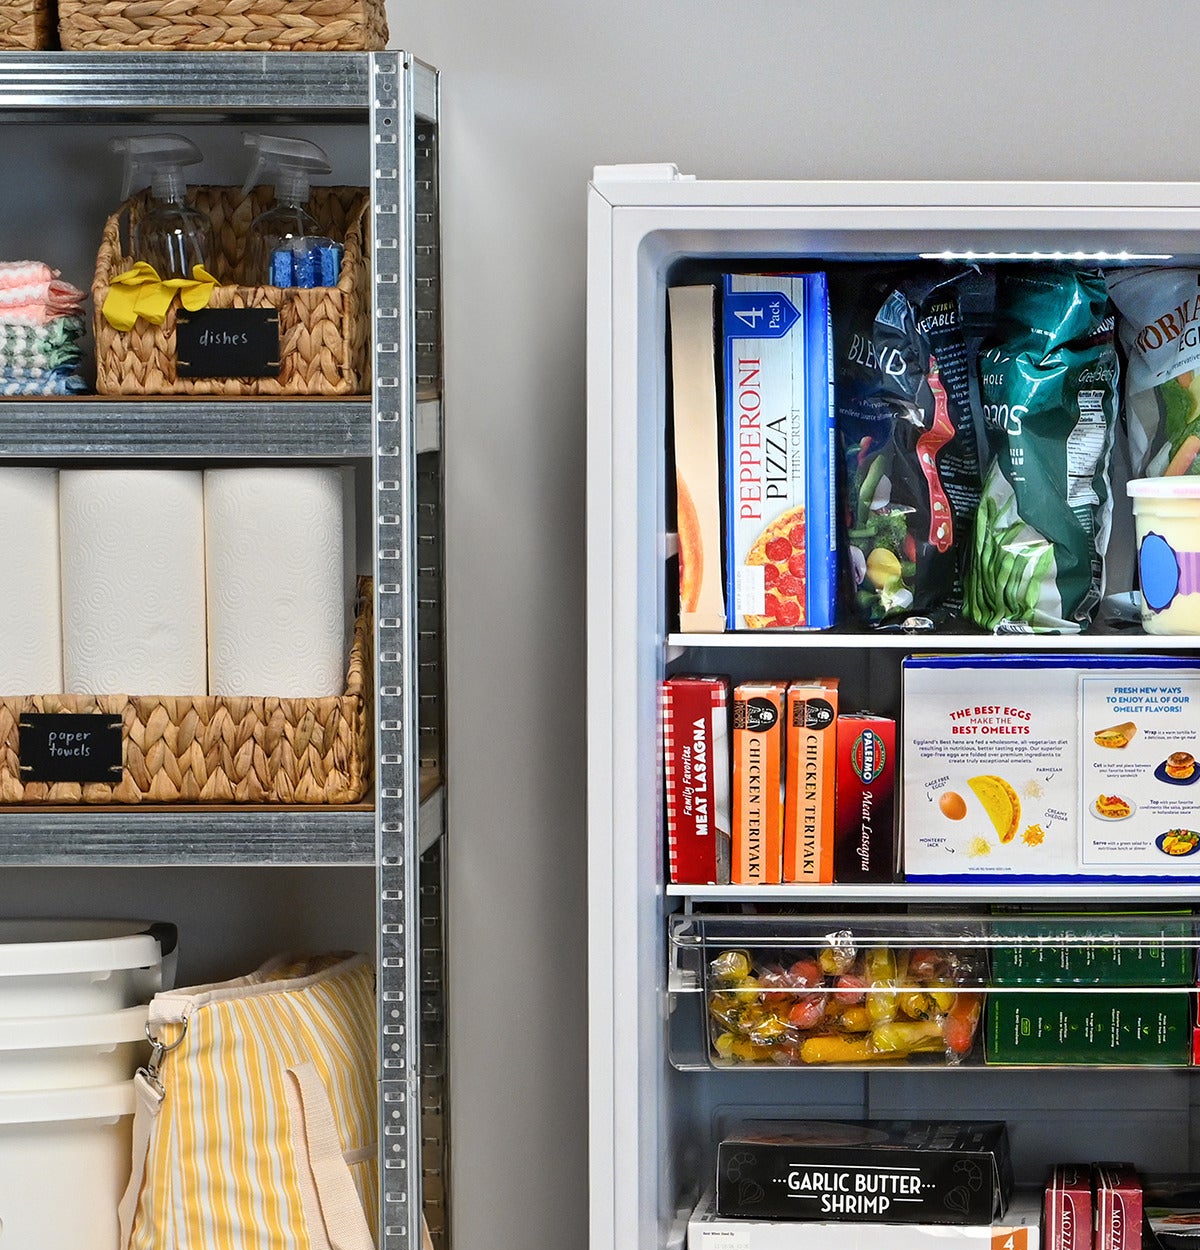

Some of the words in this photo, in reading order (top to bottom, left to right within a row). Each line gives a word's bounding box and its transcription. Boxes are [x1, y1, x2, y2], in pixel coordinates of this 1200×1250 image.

[735, 306, 764, 328] 4
[769, 300, 781, 329] Pack
[200, 329, 248, 346] dishes
[738, 357, 762, 521] PEPPERONI
[791, 409, 801, 447] CRUST
[766, 415, 788, 501] PIZZA
[791, 450, 801, 481] THIN
[950, 707, 972, 721] THE
[974, 705, 1001, 715] BEST
[1003, 706, 1032, 721] EGGS
[48, 729, 91, 747] paper
[952, 726, 978, 734] BEST
[981, 726, 1030, 734] OMELETS
[48, 742, 91, 758] towels
[682, 745, 692, 784] Favorites
[693, 717, 707, 792] LASAGNA
[862, 731, 873, 781] PALERMO
[749, 738, 761, 803] CHICKEN
[804, 735, 818, 801] CHICKEN
[683, 785, 694, 817] Family
[861, 791, 873, 822] Meat
[695, 799, 709, 836] MEAT
[748, 808, 760, 878] TERIYAKI
[803, 805, 817, 875] TERIYAKI
[856, 822, 873, 872] Lasagna
[787, 1170, 850, 1193] GARLIC
[854, 1172, 922, 1195] BUTTER
[820, 1194, 890, 1215] SHRIMP
[1002, 1234, 1015, 1250] 4
